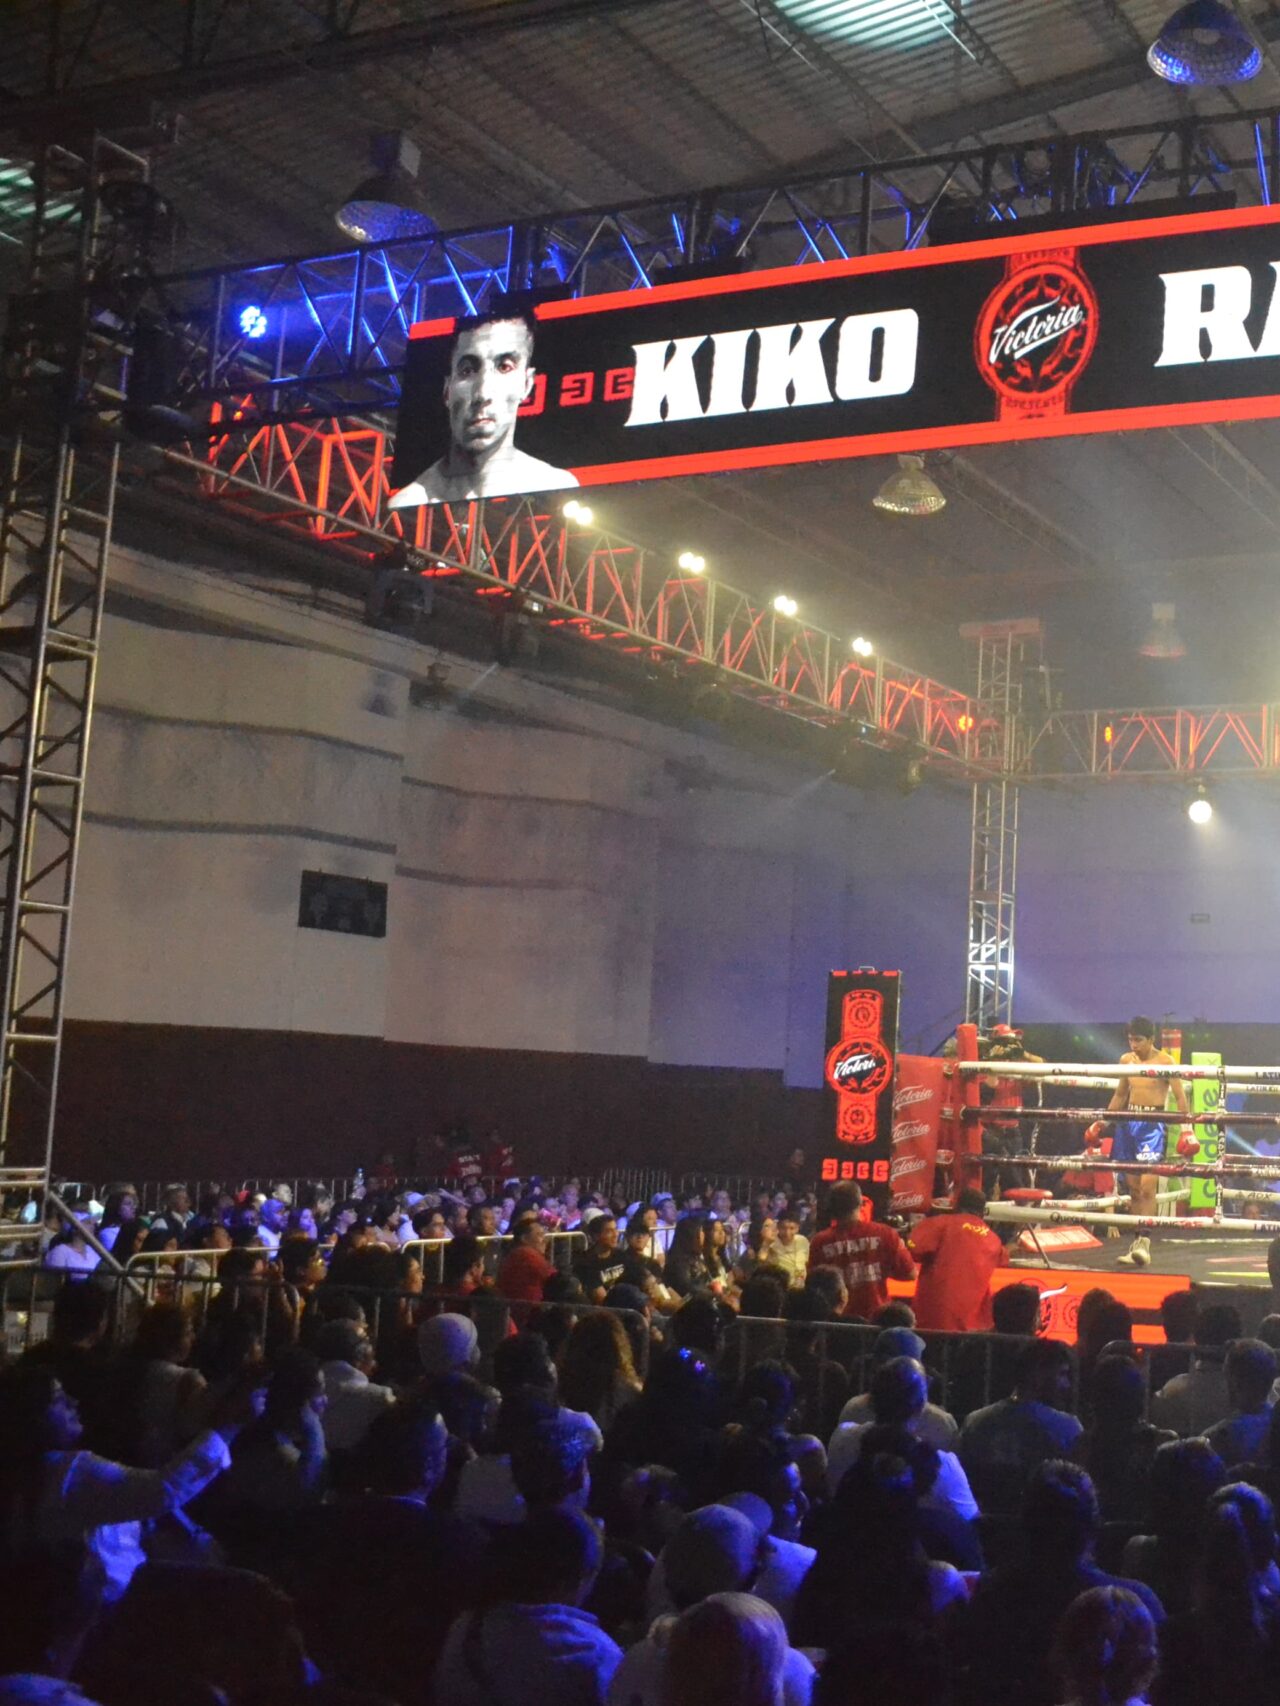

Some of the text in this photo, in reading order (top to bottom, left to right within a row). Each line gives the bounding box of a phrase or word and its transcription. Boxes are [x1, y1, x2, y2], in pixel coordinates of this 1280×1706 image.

[988, 295, 1085, 365] Victoria
[623, 308, 919, 427] KIKO
[822, 1236, 881, 1258] STAFF
